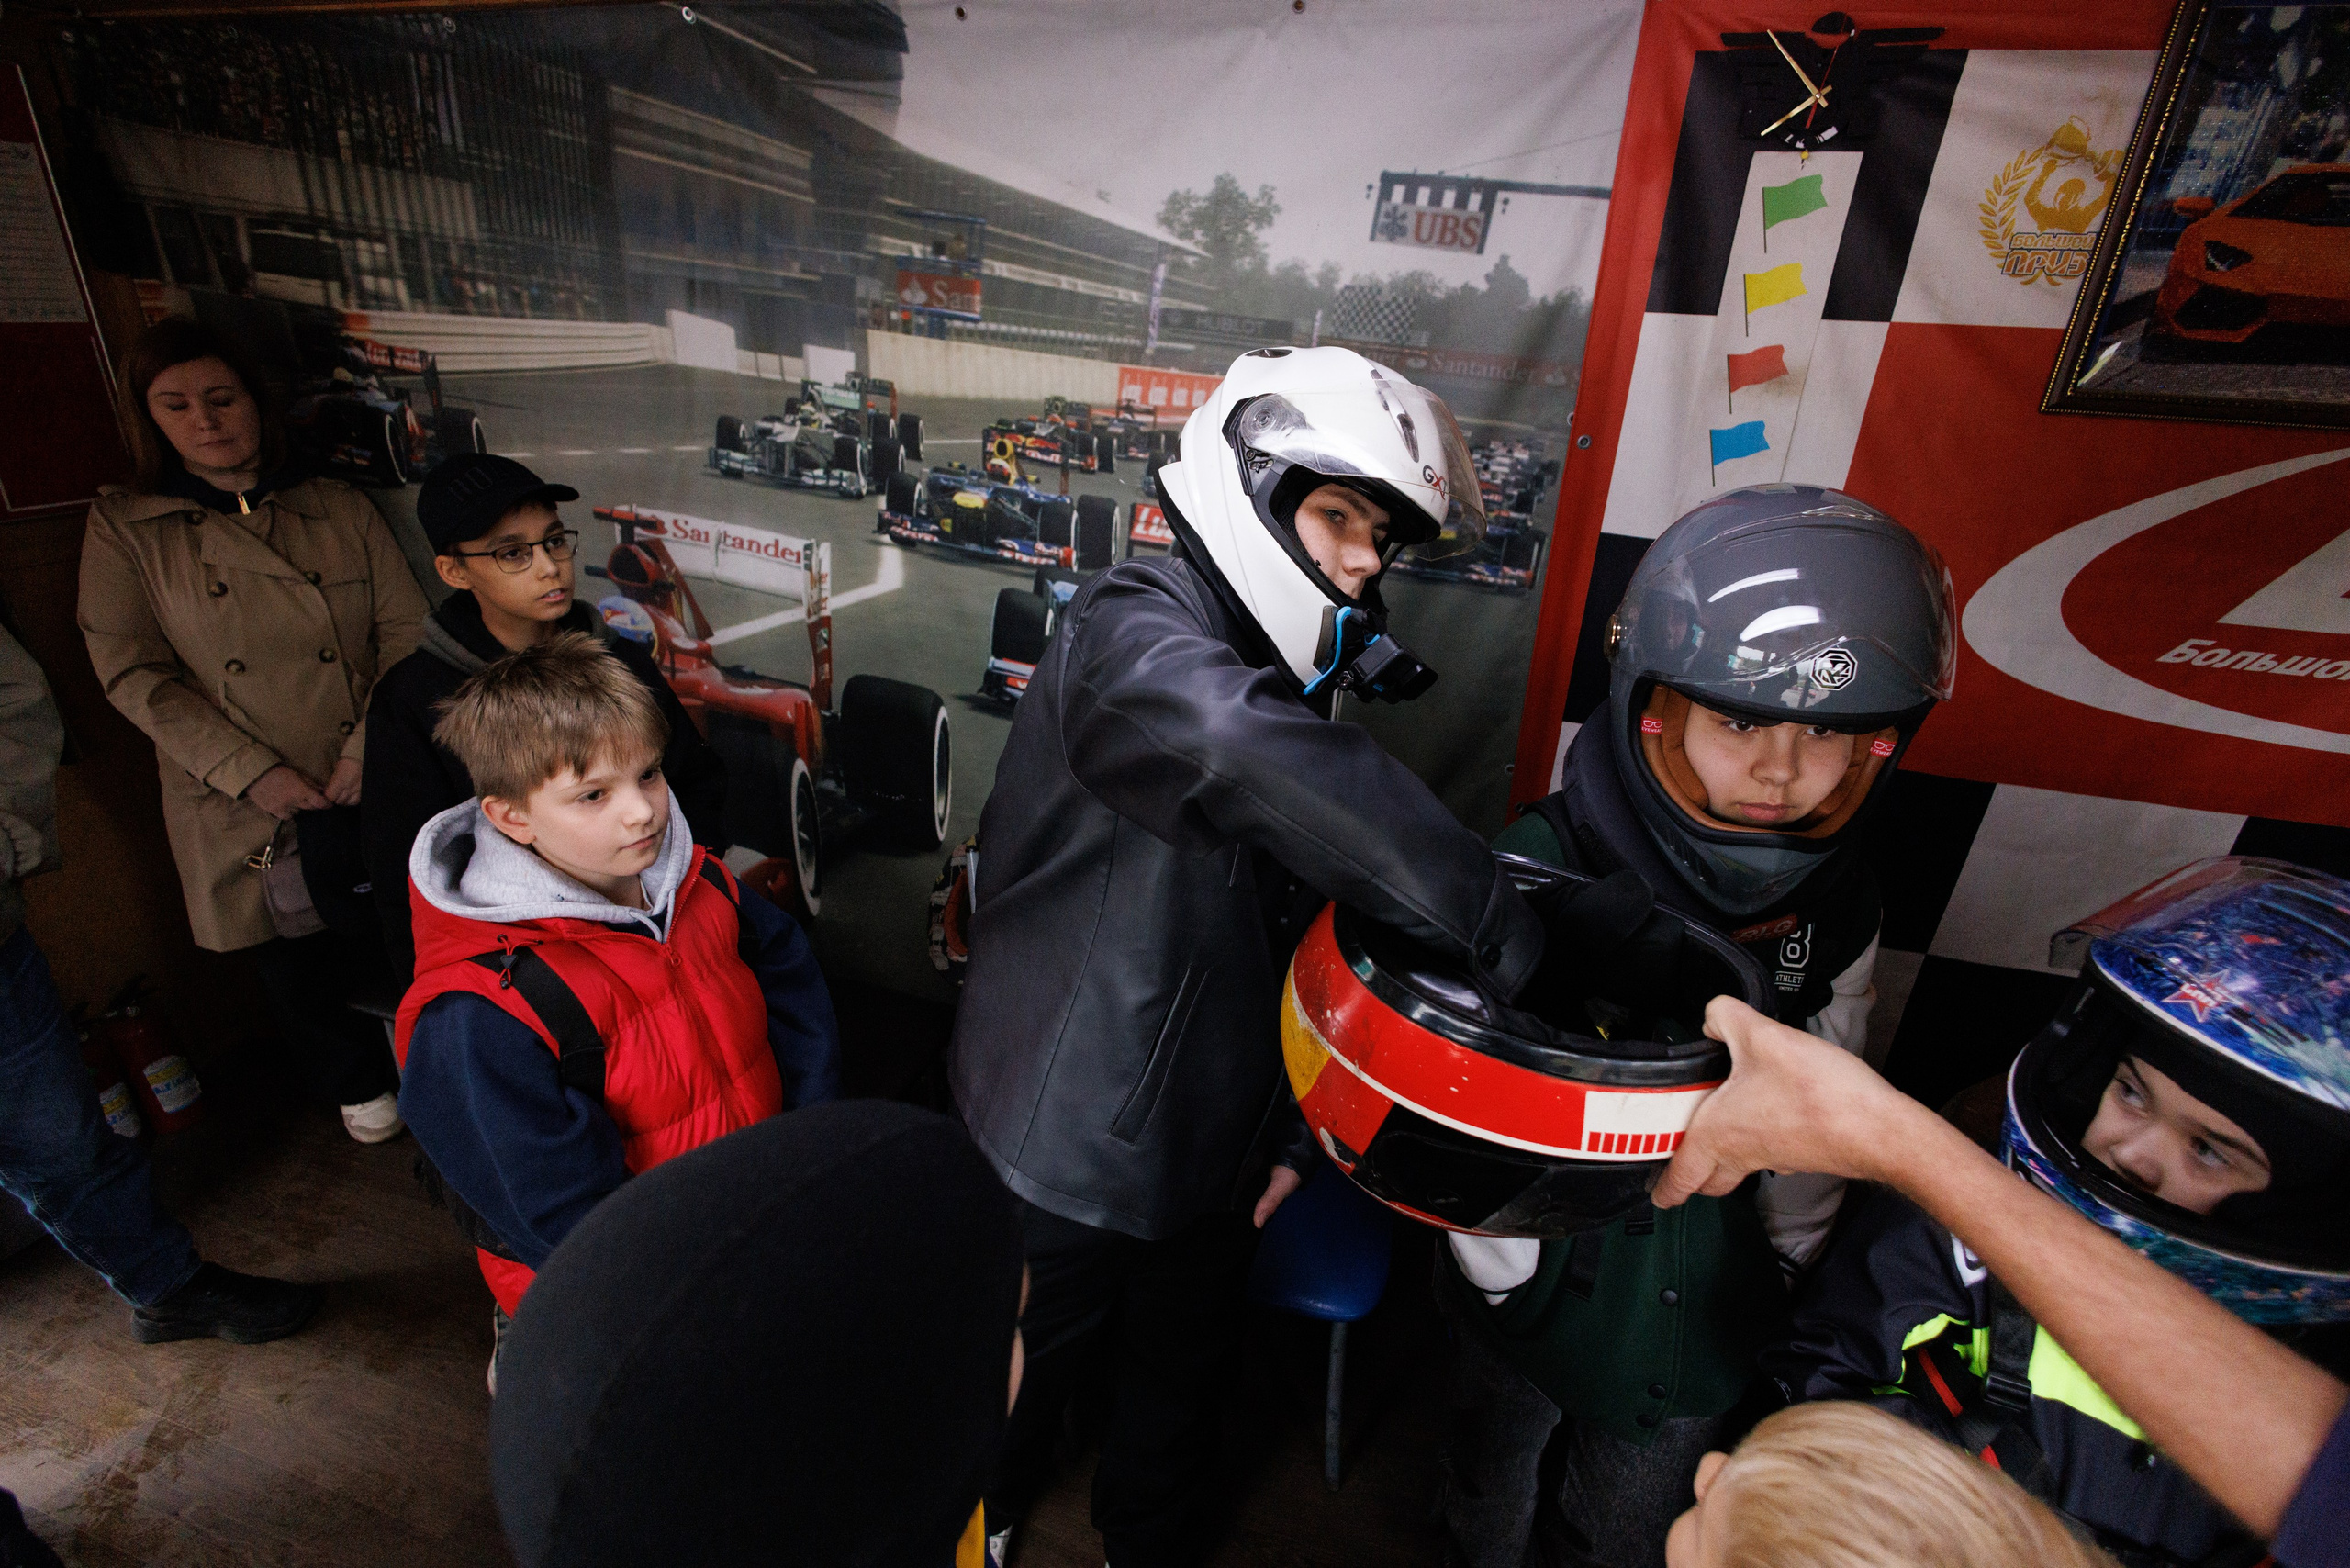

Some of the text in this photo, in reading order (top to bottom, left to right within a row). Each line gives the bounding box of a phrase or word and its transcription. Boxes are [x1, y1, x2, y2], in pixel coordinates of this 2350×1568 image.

[1415, 211, 1480, 249] UBS
[2003, 249, 2091, 275] ПРИЗ
[2155, 638, 2350, 681] Большо
